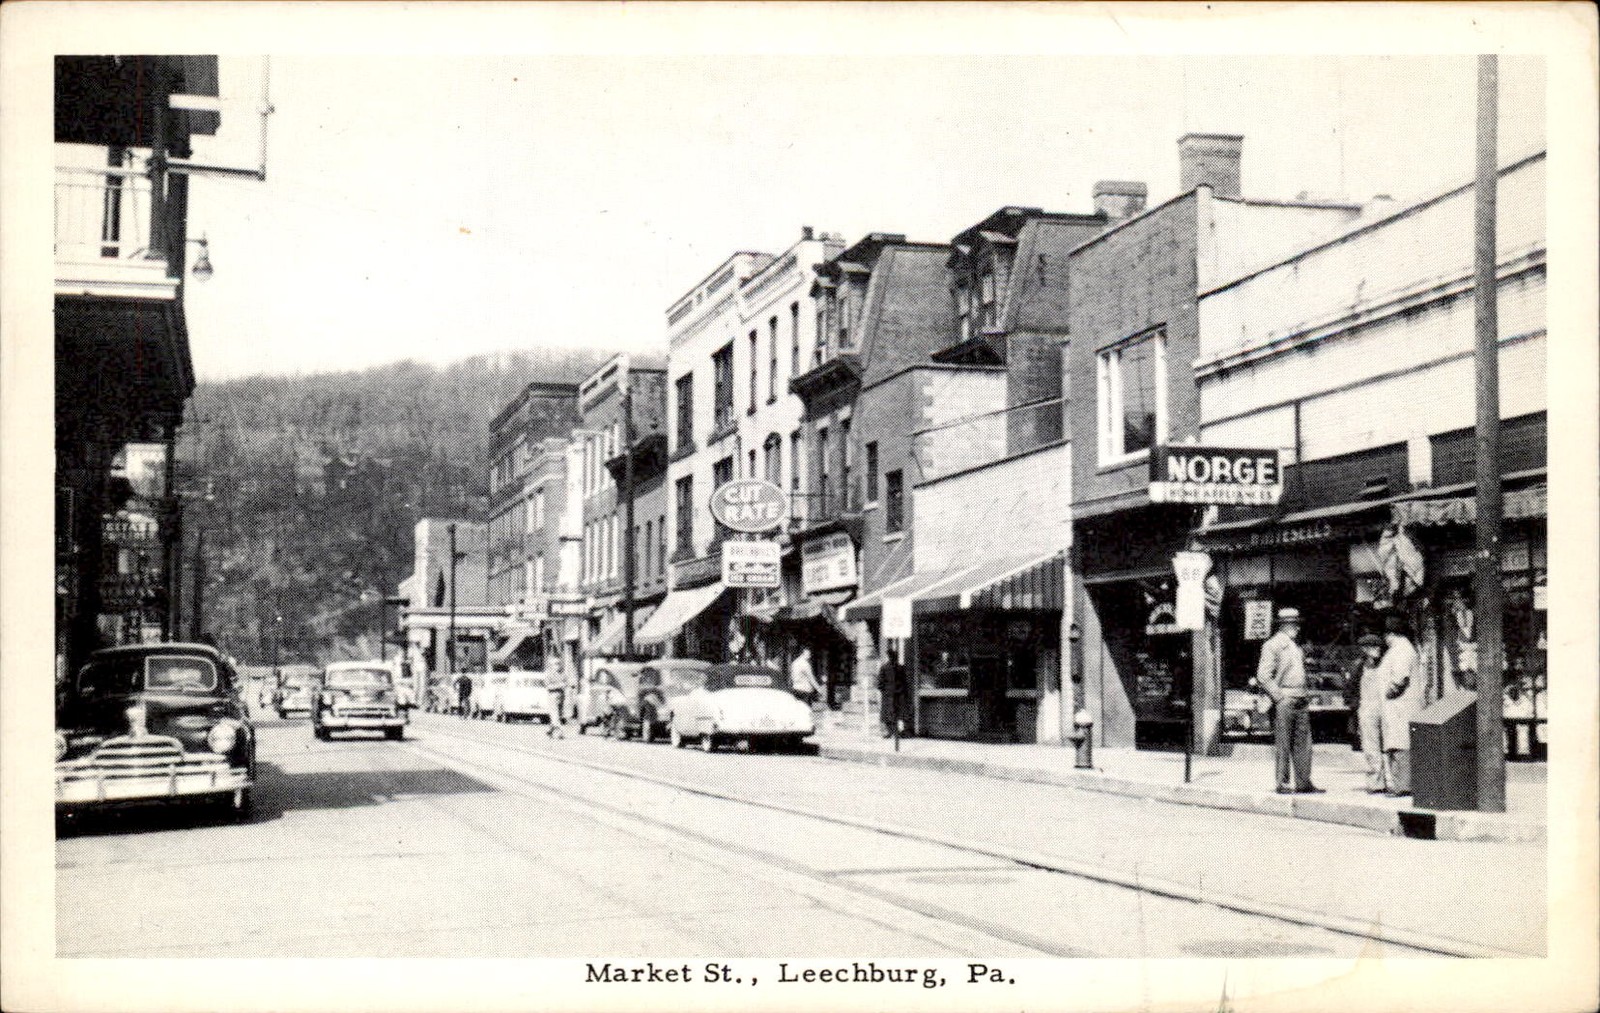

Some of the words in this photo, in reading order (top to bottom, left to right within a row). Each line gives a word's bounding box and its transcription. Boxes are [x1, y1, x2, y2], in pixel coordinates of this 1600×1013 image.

[1167, 455, 1276, 485] NORGE
[723, 485, 762, 504] CUT
[1203, 488, 1273, 501] APPLIANCES
[724, 502, 780, 522] RATE
